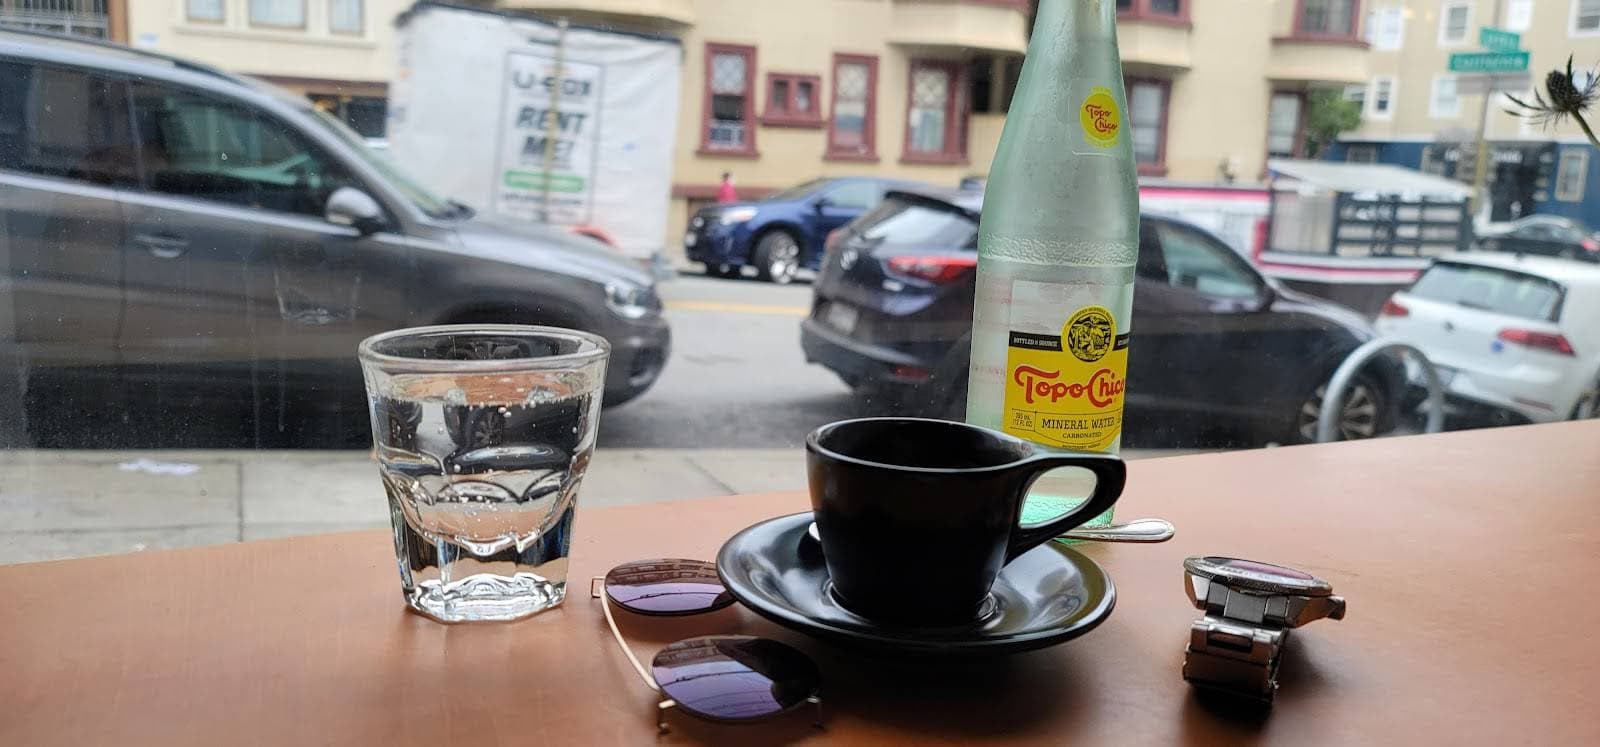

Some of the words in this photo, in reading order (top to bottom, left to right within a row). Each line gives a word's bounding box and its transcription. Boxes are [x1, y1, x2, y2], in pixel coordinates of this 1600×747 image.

[1085, 104, 1112, 119] Topo
[515, 105, 590, 136] RENT
[1094, 118, 1118, 132] Chico
[1013, 336, 1035, 345] BOTTLED
[1014, 364, 1088, 404] Topo
[1041, 418, 1089, 430] MINERAL
[1091, 416, 1116, 429] WATER
[1062, 431, 1102, 440] CARBONATED
